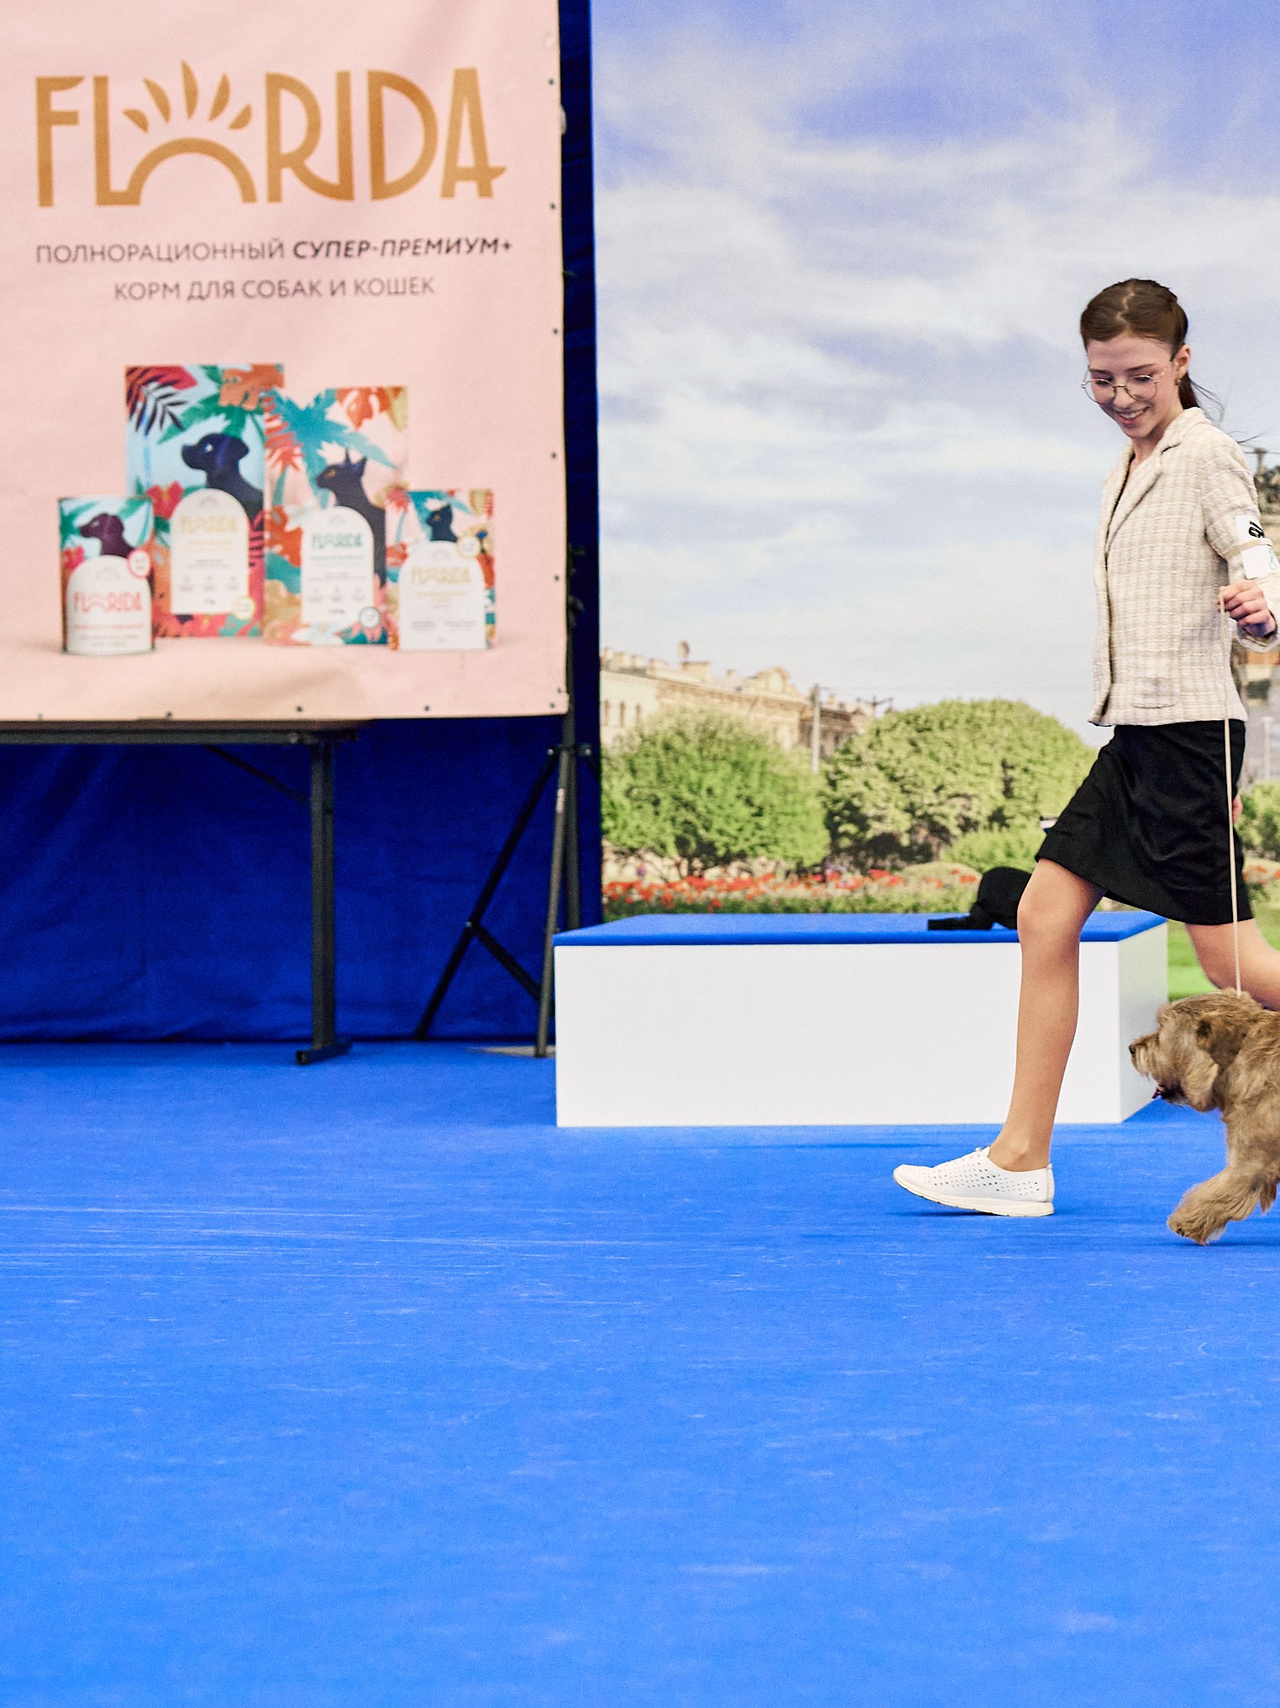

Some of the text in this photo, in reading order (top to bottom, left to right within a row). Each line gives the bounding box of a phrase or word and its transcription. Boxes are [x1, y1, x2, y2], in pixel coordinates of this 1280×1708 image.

[36, 60, 507, 207] FLORIDA
[36, 237, 513, 263] ПОЛНОРАЦИОННЫЙ СУПЕР-ПРЕМИУМ+
[114, 276, 436, 301] КОРМ ДЛЯ СОБАК И КОШЕК
